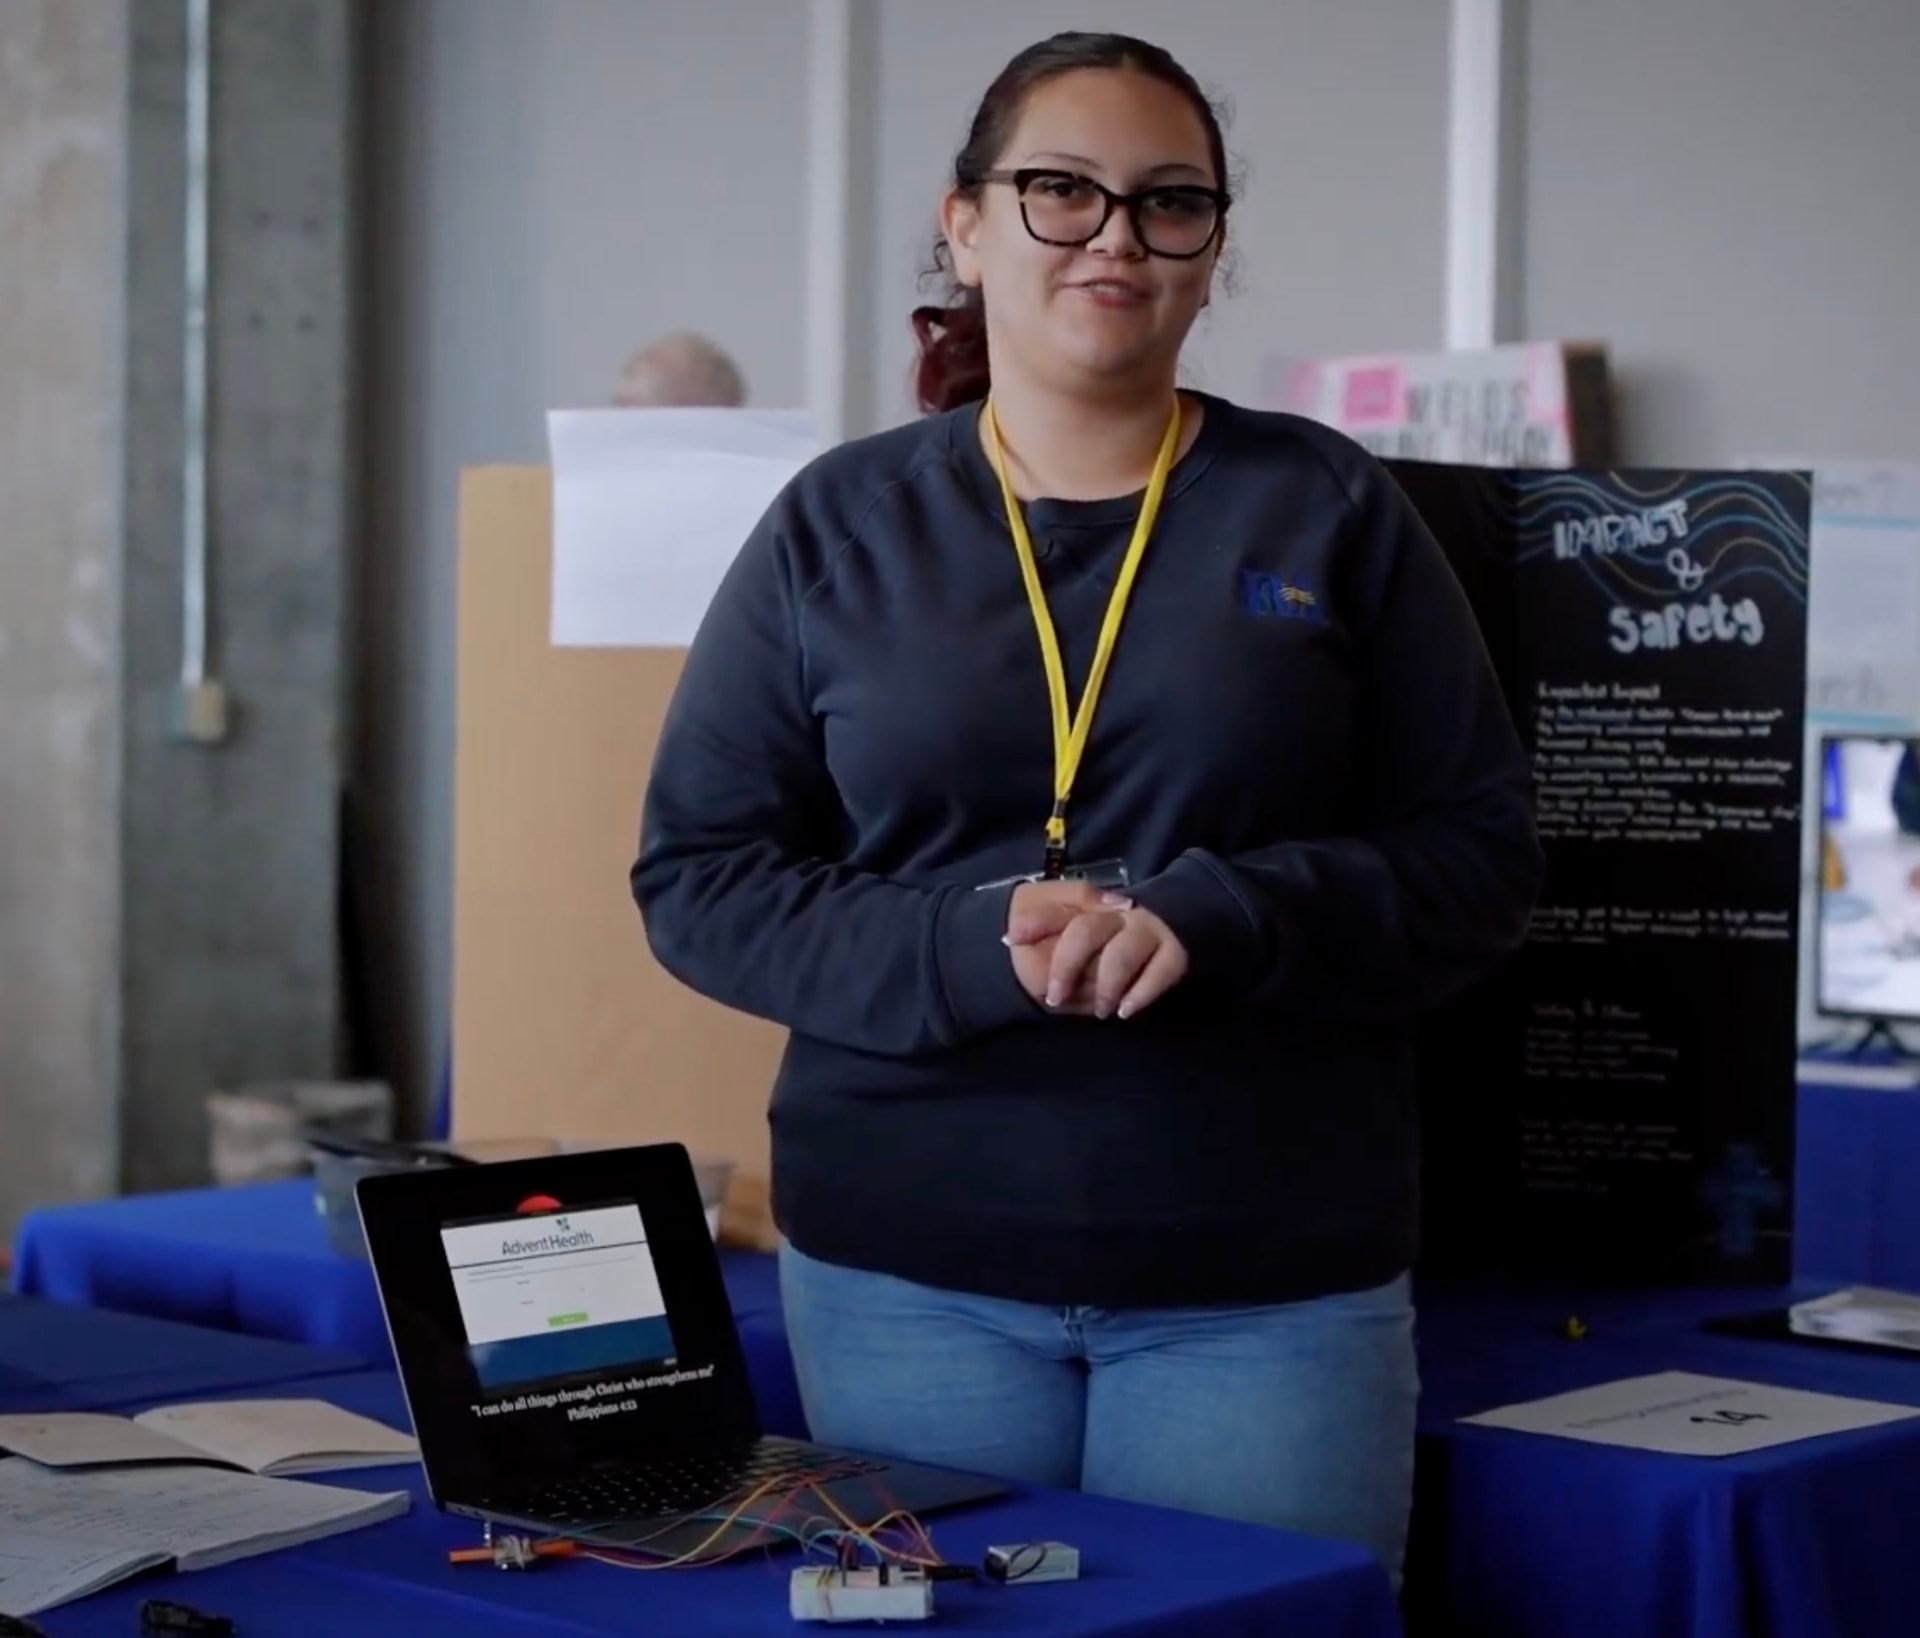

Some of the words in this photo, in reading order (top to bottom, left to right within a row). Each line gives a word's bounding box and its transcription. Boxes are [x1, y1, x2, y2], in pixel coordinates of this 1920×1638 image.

[1553, 498, 1690, 560] IMPACT
[1664, 546, 1708, 592] &
[1608, 592, 1765, 655] Safety
[502, 1229, 594, 1255] AdventHealth
[482, 1403, 501, 1416] can
[501, 1399, 514, 1413] do
[515, 1396, 527, 1411] all
[527, 1394, 558, 1408] things
[557, 1384, 596, 1403] through
[596, 1381, 625, 1396] Christ
[625, 1376, 646, 1391] who
[646, 1369, 698, 1387] strengthens
[567, 1402, 619, 1422] Philippians
